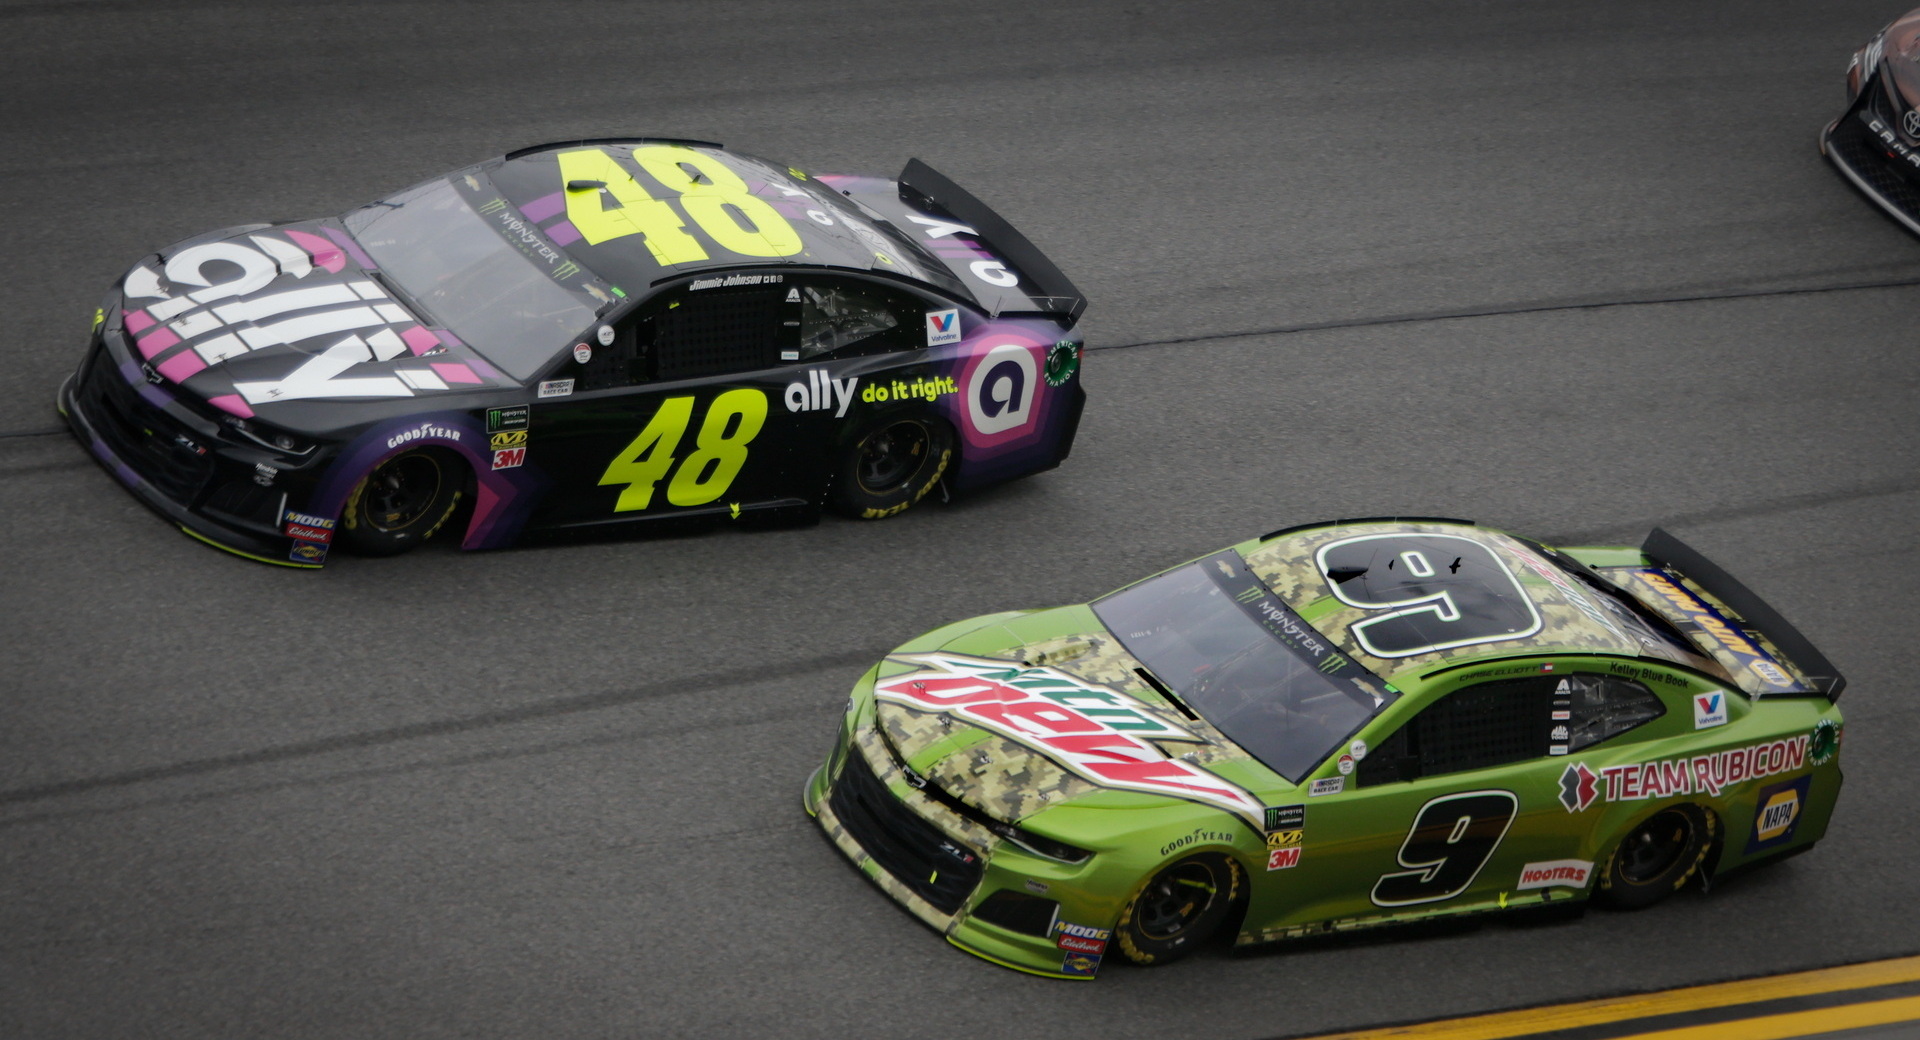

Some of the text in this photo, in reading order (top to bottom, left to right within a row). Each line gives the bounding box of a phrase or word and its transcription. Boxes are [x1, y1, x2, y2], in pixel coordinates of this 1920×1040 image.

[557, 146, 804, 267] 48
[689, 275, 763, 292] Jimmie Johnson
[123, 234, 450, 406] ally
[931, 333, 957, 343] Valvoline
[1046, 340, 1079, 361] AMERICAN
[1043, 368, 1075, 388] ETHANOL
[784, 369, 959, 418] ally do it right.
[493, 448, 525, 469] 3M
[597, 388, 769, 513] 48
[286, 511, 336, 529] MOOG
[1314, 532, 1544, 659] 9
[1258, 600, 1325, 657] MONSTER
[1609, 661, 1689, 689] Kelley Blue Book
[1698, 715, 1723, 725] Valvoline
[1600, 736, 1804, 802] TEAM RUBICON
[1761, 803, 1792, 831] NAPA
[1160, 828, 1233, 856] GOODYEAR
[1370, 789, 1519, 907] 9
[1269, 848, 1300, 870] 3M
[1521, 866, 1587, 884] HOOTERS
[1054, 921, 1112, 940] MOOG
[1060, 938, 1101, 952] Edelbrock
